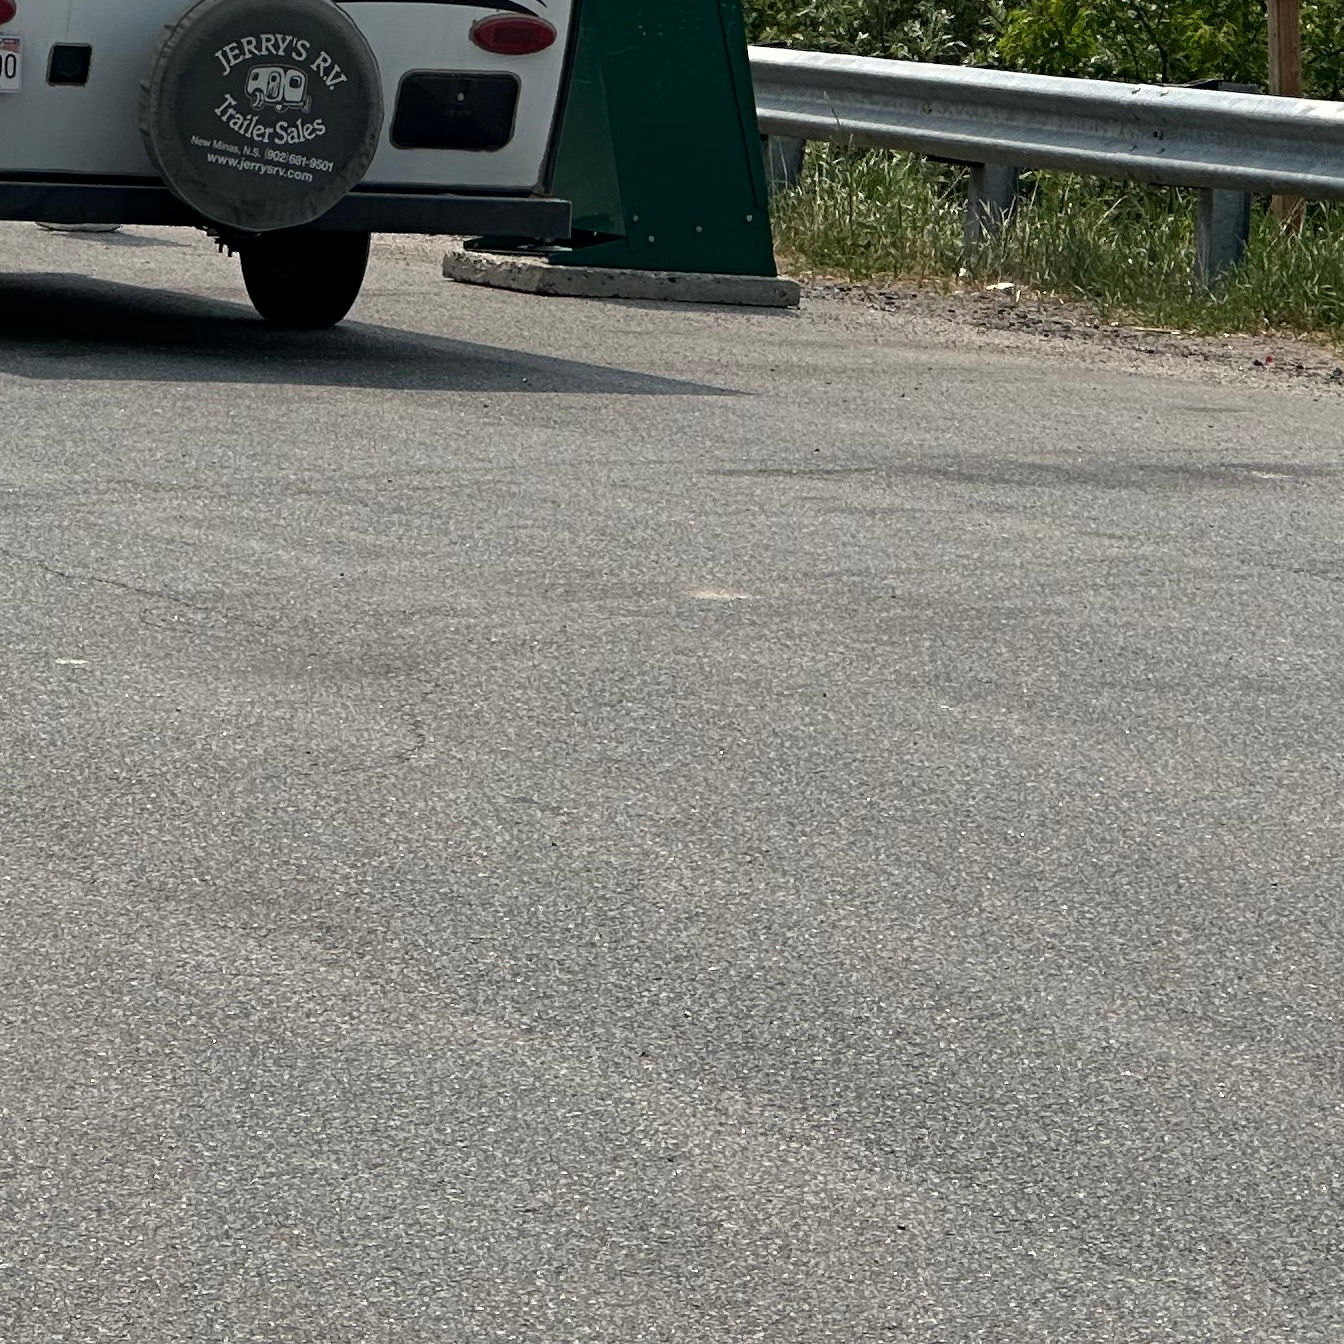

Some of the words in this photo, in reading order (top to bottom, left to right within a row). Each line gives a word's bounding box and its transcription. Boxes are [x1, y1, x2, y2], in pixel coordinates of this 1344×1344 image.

[214, 33, 311, 77] JERRY'S
[214, 93, 274, 143] Trailer
[274, 118, 327, 145] Sales
[207, 153, 313, 183] www.jerrysrv.com
